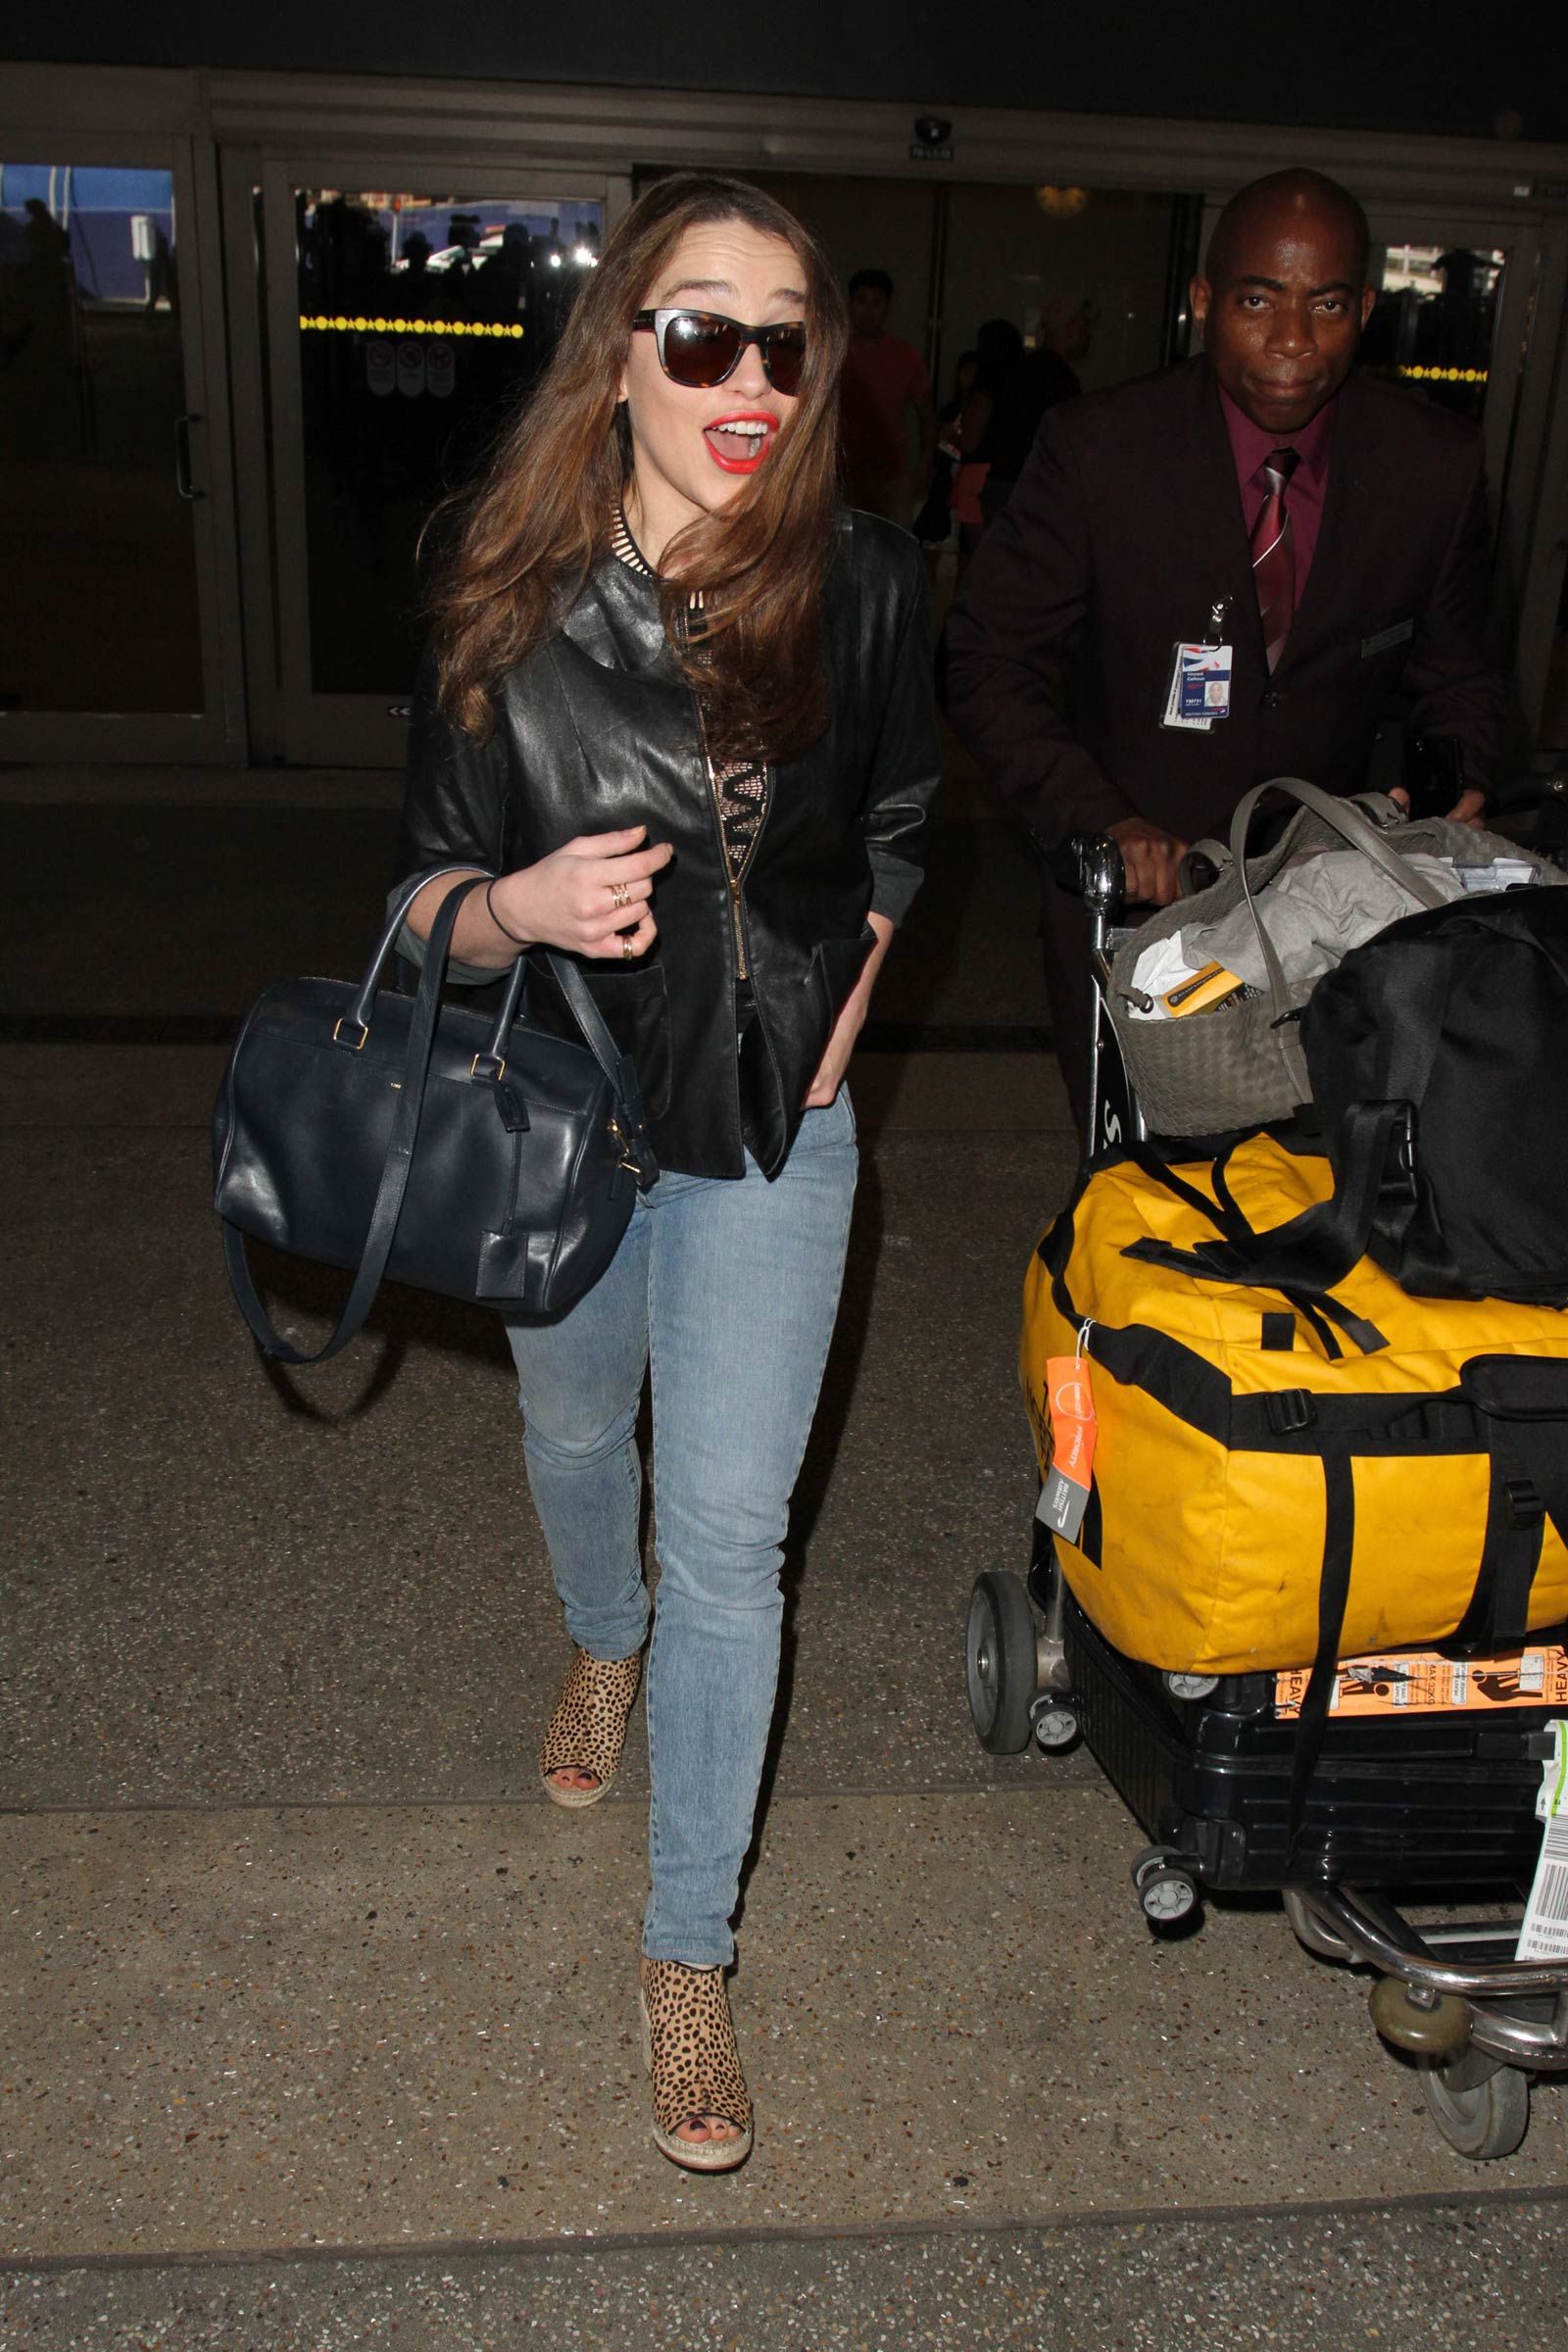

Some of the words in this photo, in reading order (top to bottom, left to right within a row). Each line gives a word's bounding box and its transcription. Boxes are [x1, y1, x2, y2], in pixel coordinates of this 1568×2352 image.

[1053, 1477, 1065, 1508] AIRWAYS
[1057, 1482, 1070, 1512] BRITISH
[1289, 1669, 1302, 1717] HEAVY
[1555, 1650, 1568, 1702] HEAVY
